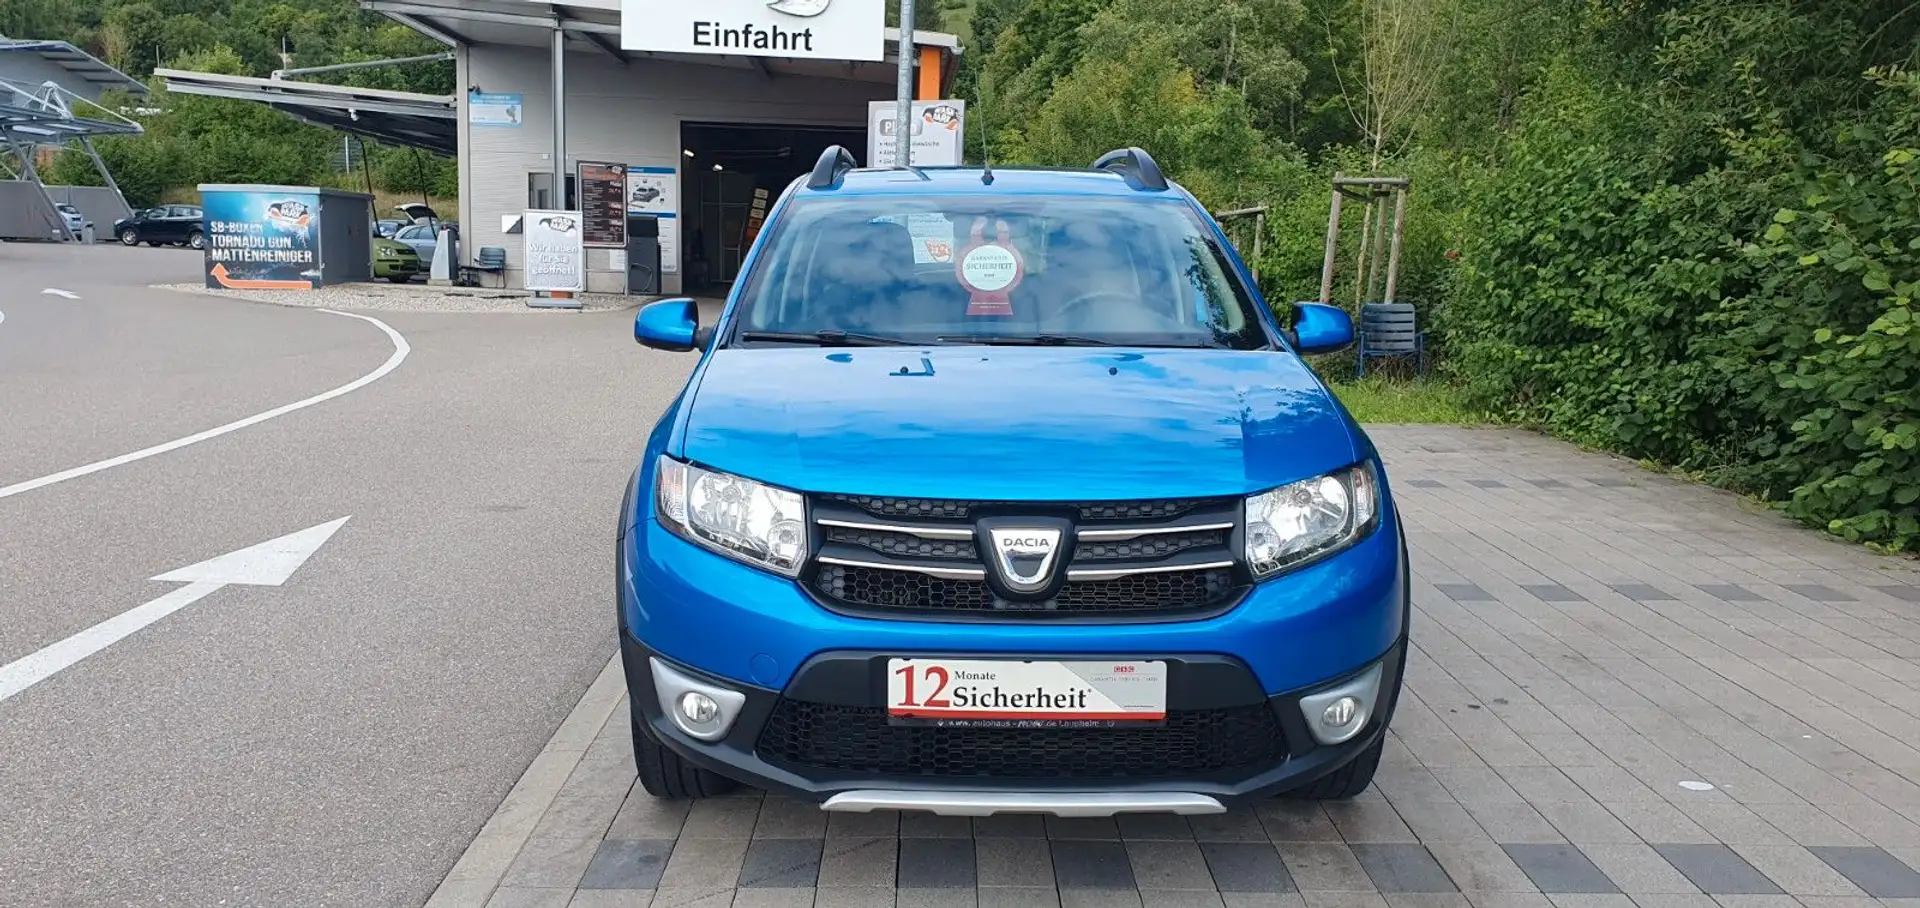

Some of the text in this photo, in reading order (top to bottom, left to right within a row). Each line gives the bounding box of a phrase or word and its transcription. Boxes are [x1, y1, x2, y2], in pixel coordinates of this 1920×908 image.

[693, 21, 813, 51] Einfahrt
[210, 234, 266, 249] TORNADO
[529, 243, 547, 252] Wir
[211, 248, 313, 263] MATTENREINIGER
[1003, 538, 1050, 547] DACIA
[895, 664, 996, 708] 12 Monate
[952, 686, 1088, 709] Sicherheit
